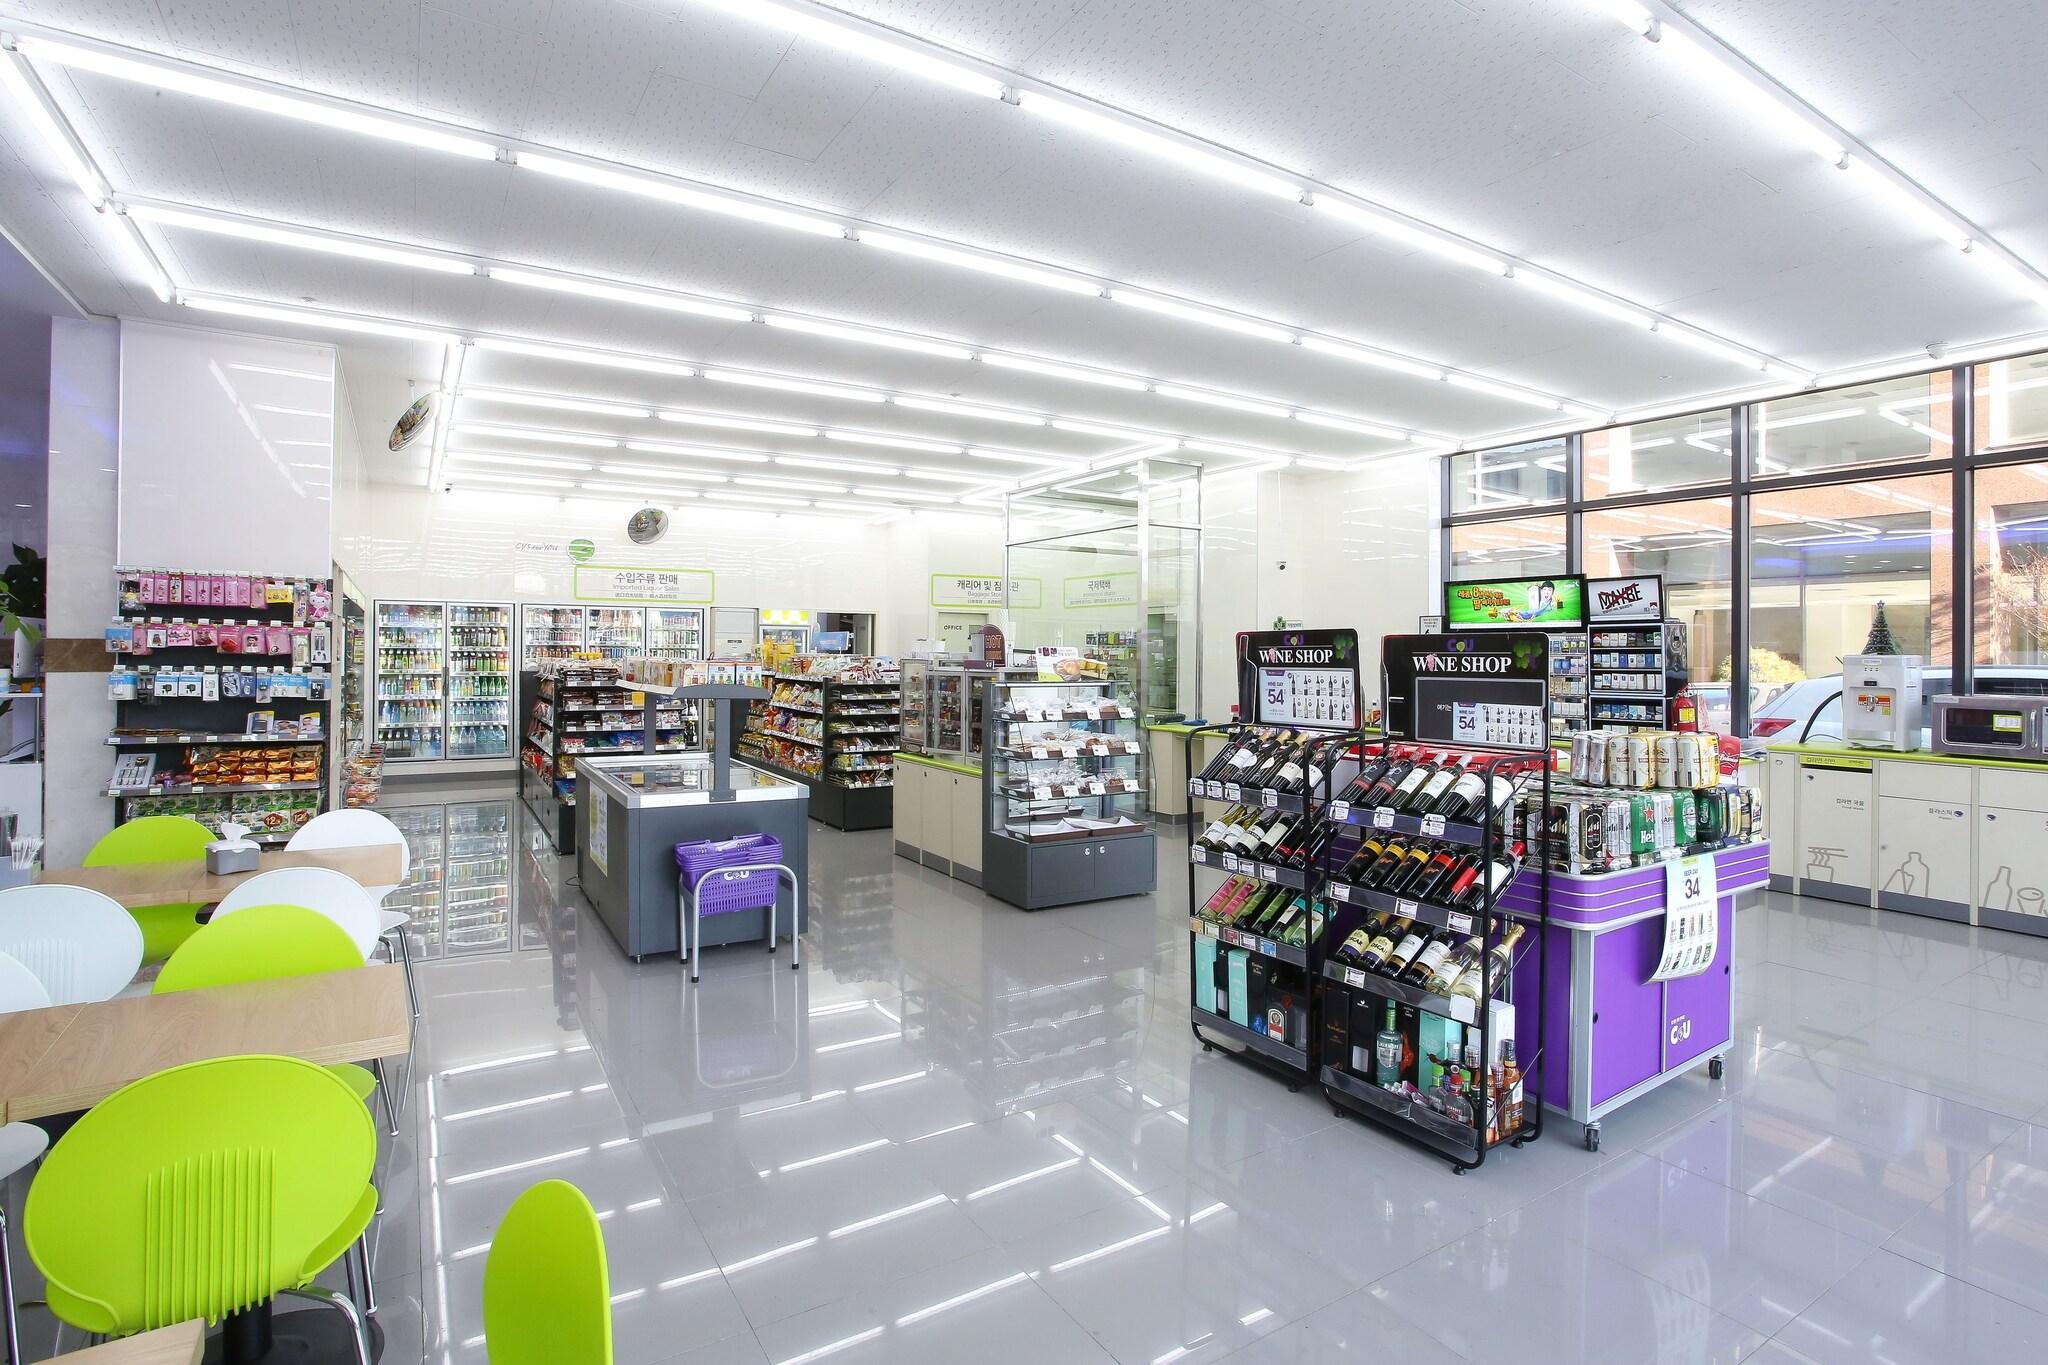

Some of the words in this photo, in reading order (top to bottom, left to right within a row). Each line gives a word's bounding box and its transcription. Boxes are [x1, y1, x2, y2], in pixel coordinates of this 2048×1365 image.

[615, 572, 656, 585] 수입주류
[658, 573, 678, 585] 판매
[957, 579, 981, 591] 캐리어
[983, 580, 992, 591] 및
[1295, 648, 1333, 663] SHOP
[1461, 656, 1512, 673] SHOP
[1267, 689, 1285, 705] 54
[1458, 715, 1476, 731] 54
[1684, 876, 1701, 899] 34
